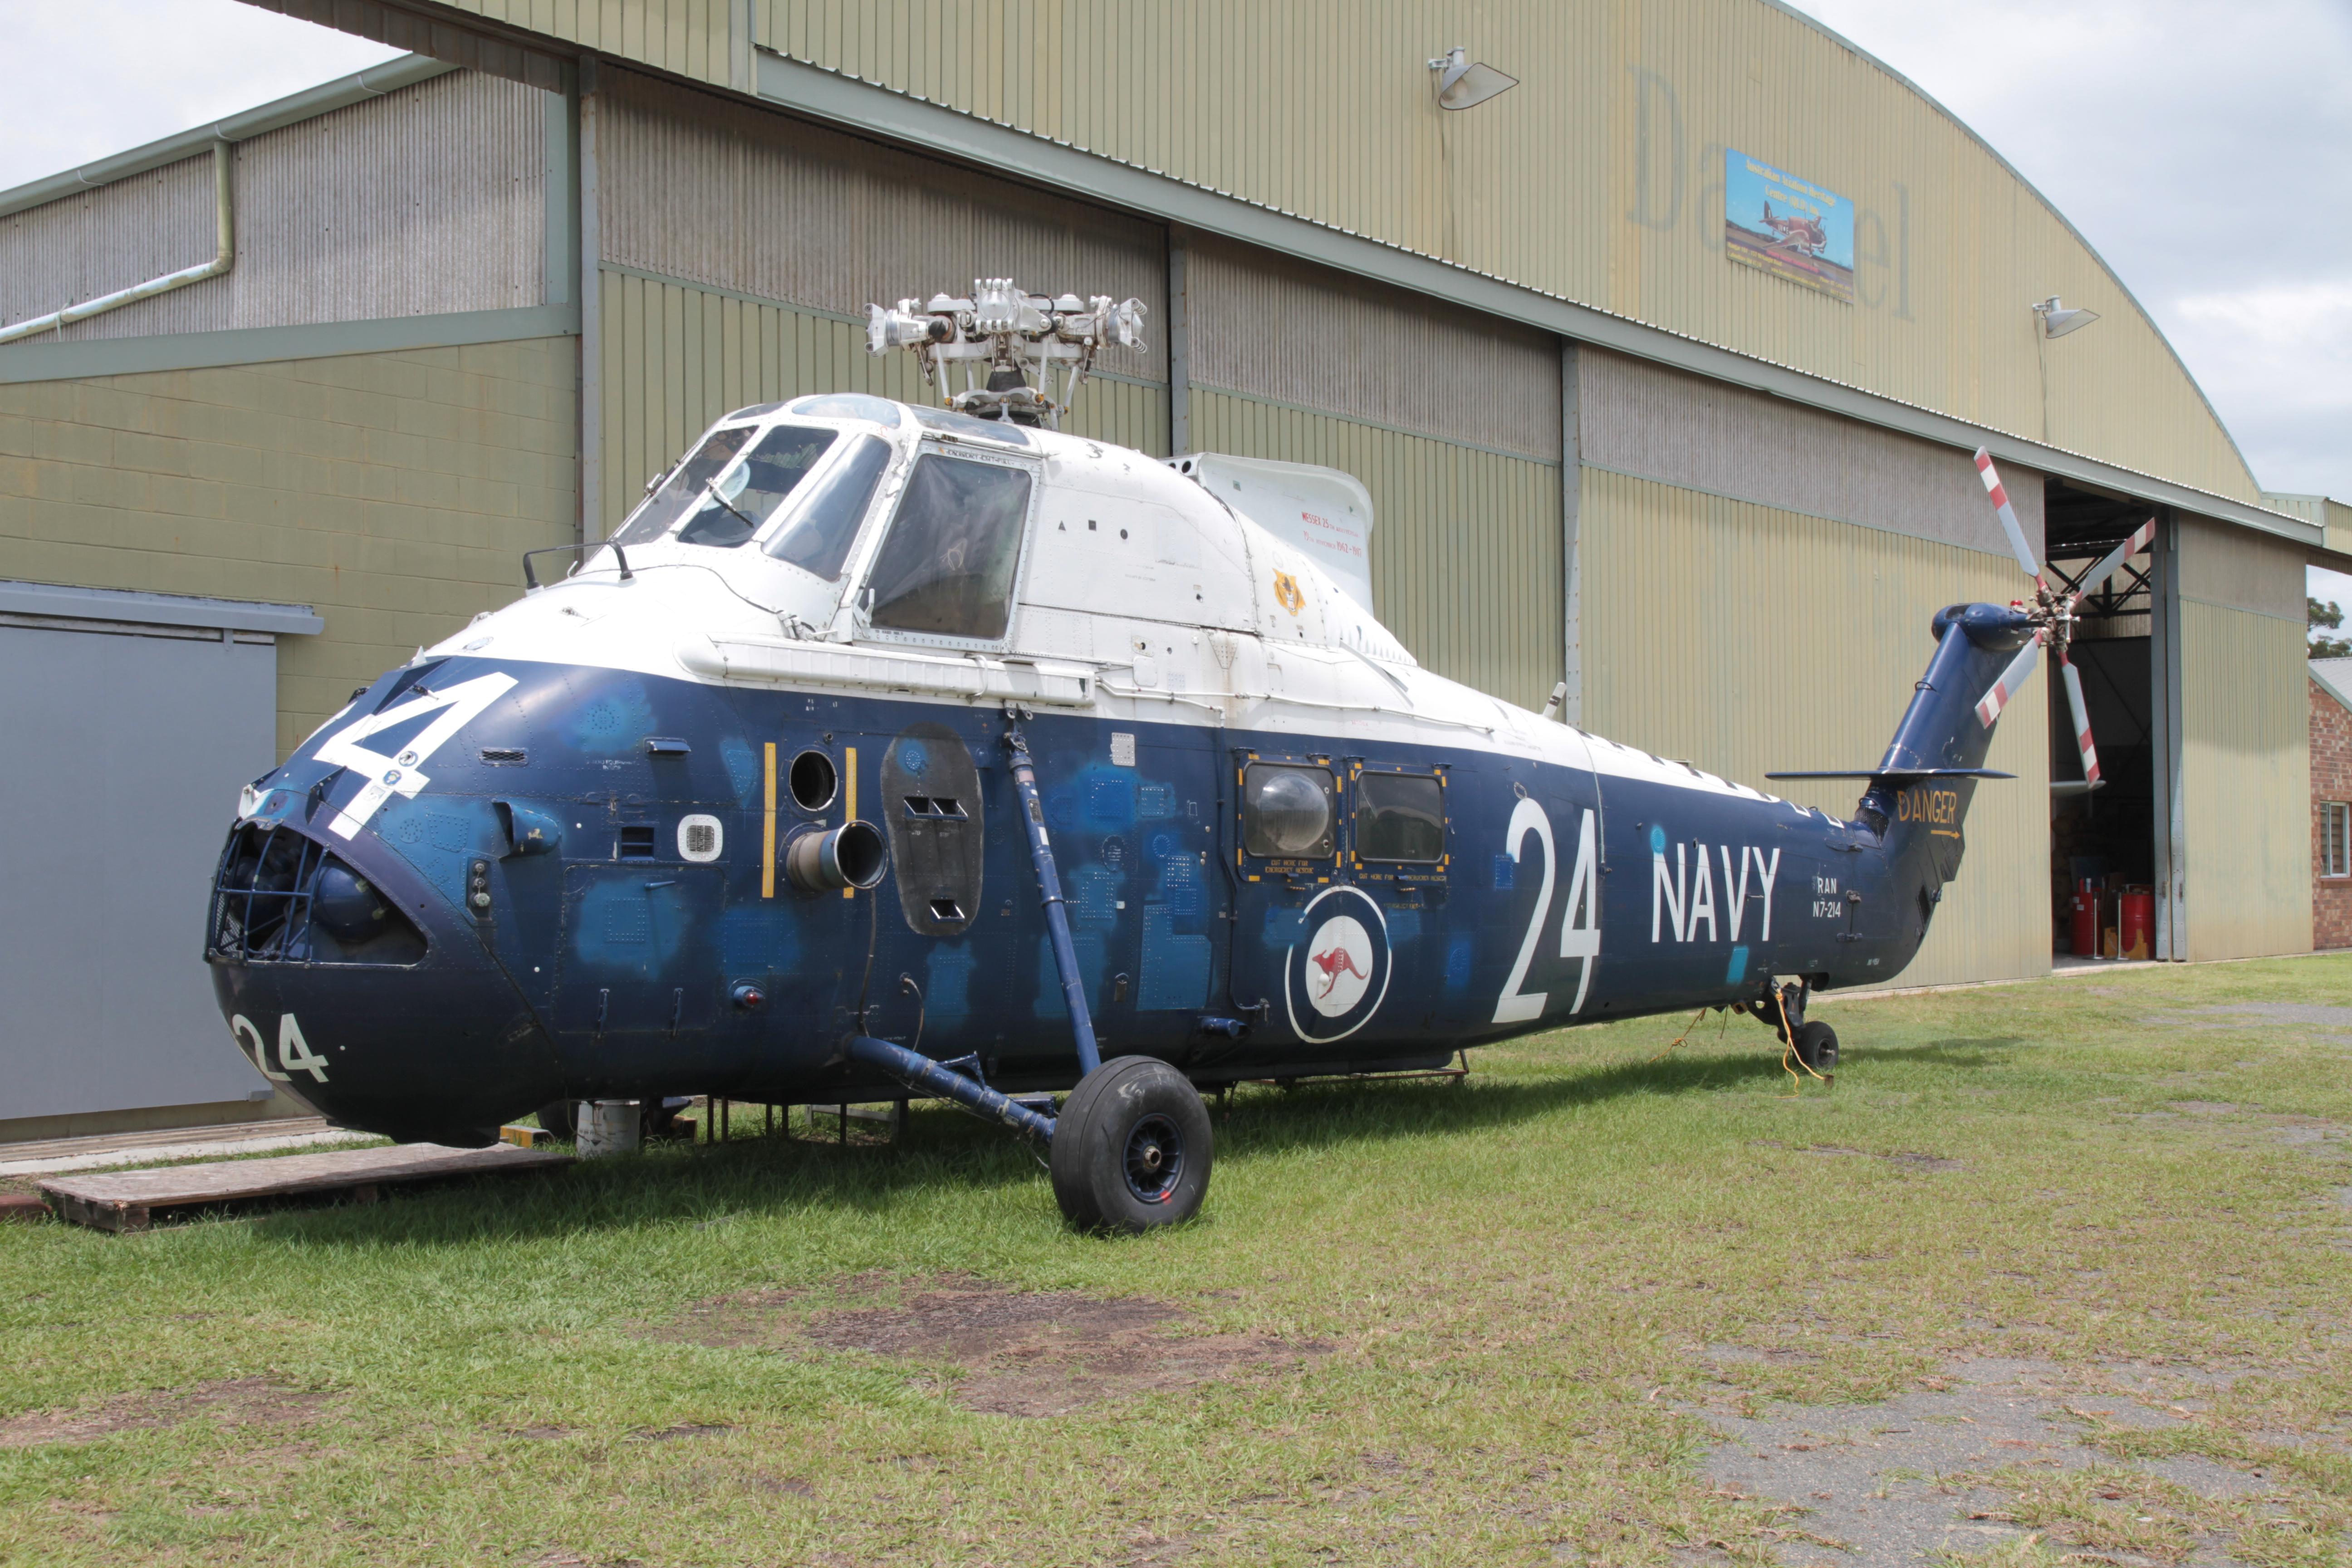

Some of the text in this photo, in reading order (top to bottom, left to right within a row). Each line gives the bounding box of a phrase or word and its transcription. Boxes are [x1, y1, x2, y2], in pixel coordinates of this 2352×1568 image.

[1746, 159, 1835, 208] Australian Aviation Heritage
[1765, 185, 1787, 204] Centre
[1301, 511, 1321, 526] WESSEX
[1897, 789, 1957, 824] DANGER
[1652, 843, 1780, 943] NAVY
[1817, 877, 1837, 894] RAN
[1491, 797, 1601, 1024] 24
[1813, 901, 1841, 917] N7-214
[232, 1013, 329, 1083] 24
